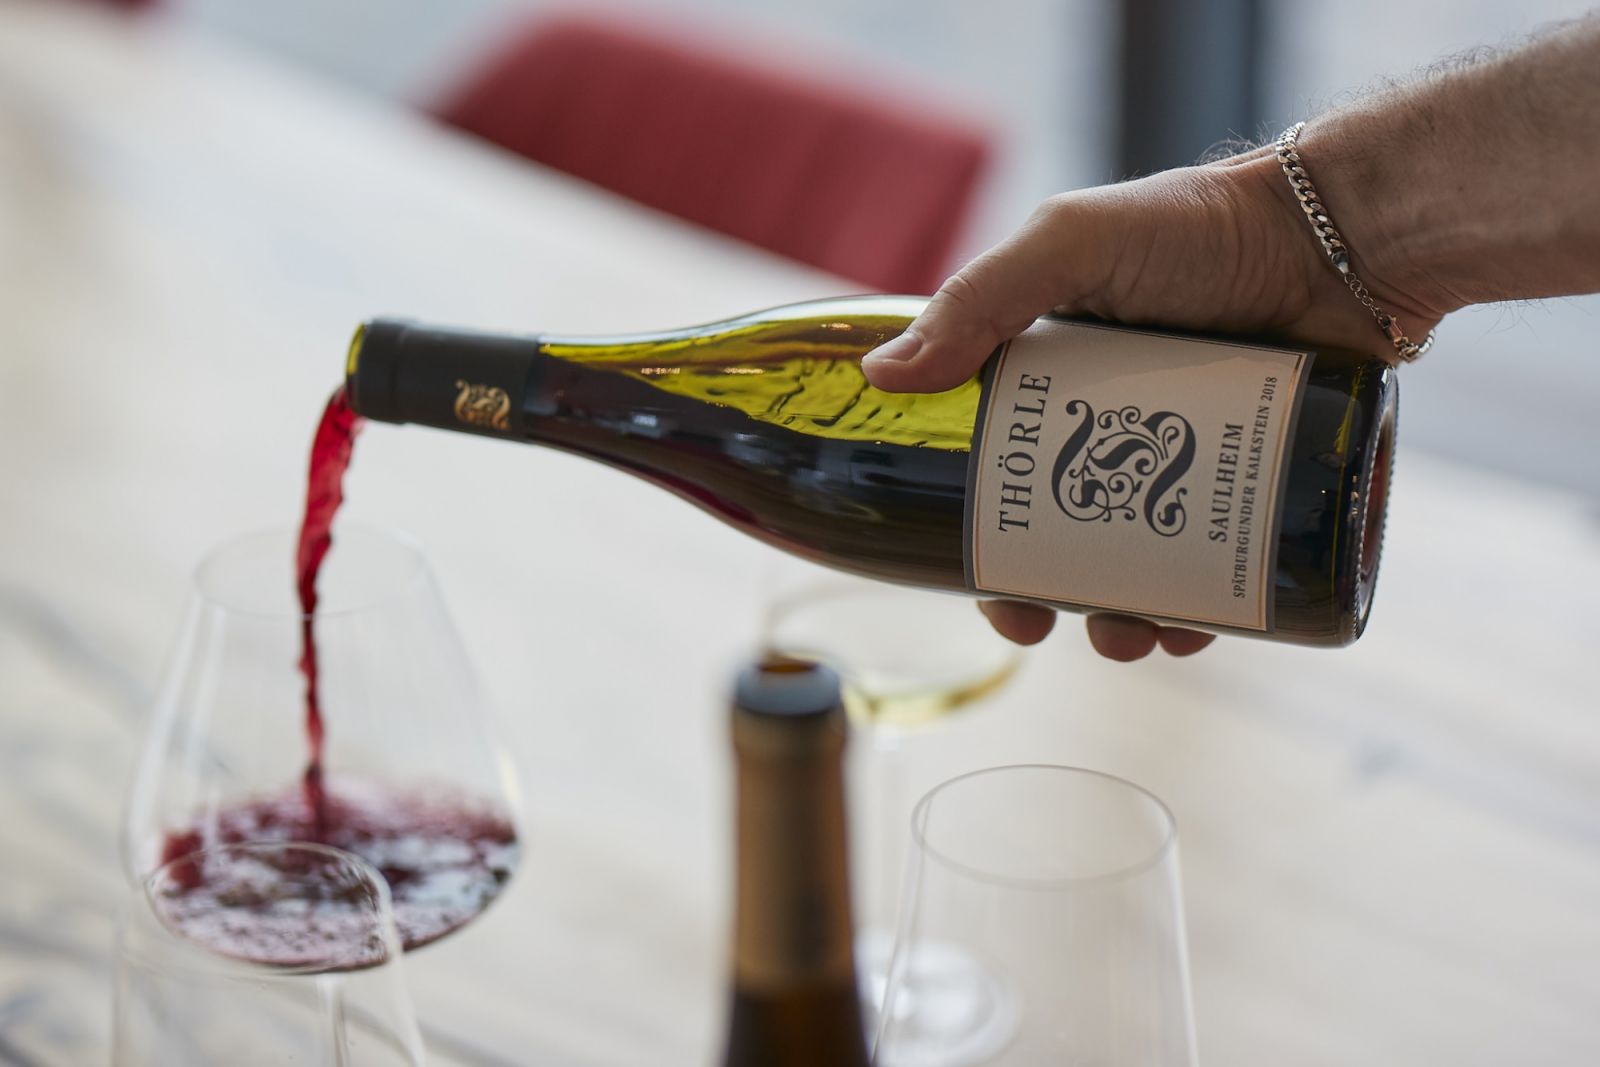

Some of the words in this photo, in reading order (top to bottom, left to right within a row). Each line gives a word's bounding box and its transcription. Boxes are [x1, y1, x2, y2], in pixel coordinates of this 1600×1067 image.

[998, 373, 1052, 532] THÖRLE
[1208, 422, 1244, 543] SAULHEIM
[1232, 486, 1256, 599] SPÄTBURGUNDER
[1245, 405, 1270, 480] KALKSTEIN
[1260, 376, 1278, 402] 2018
